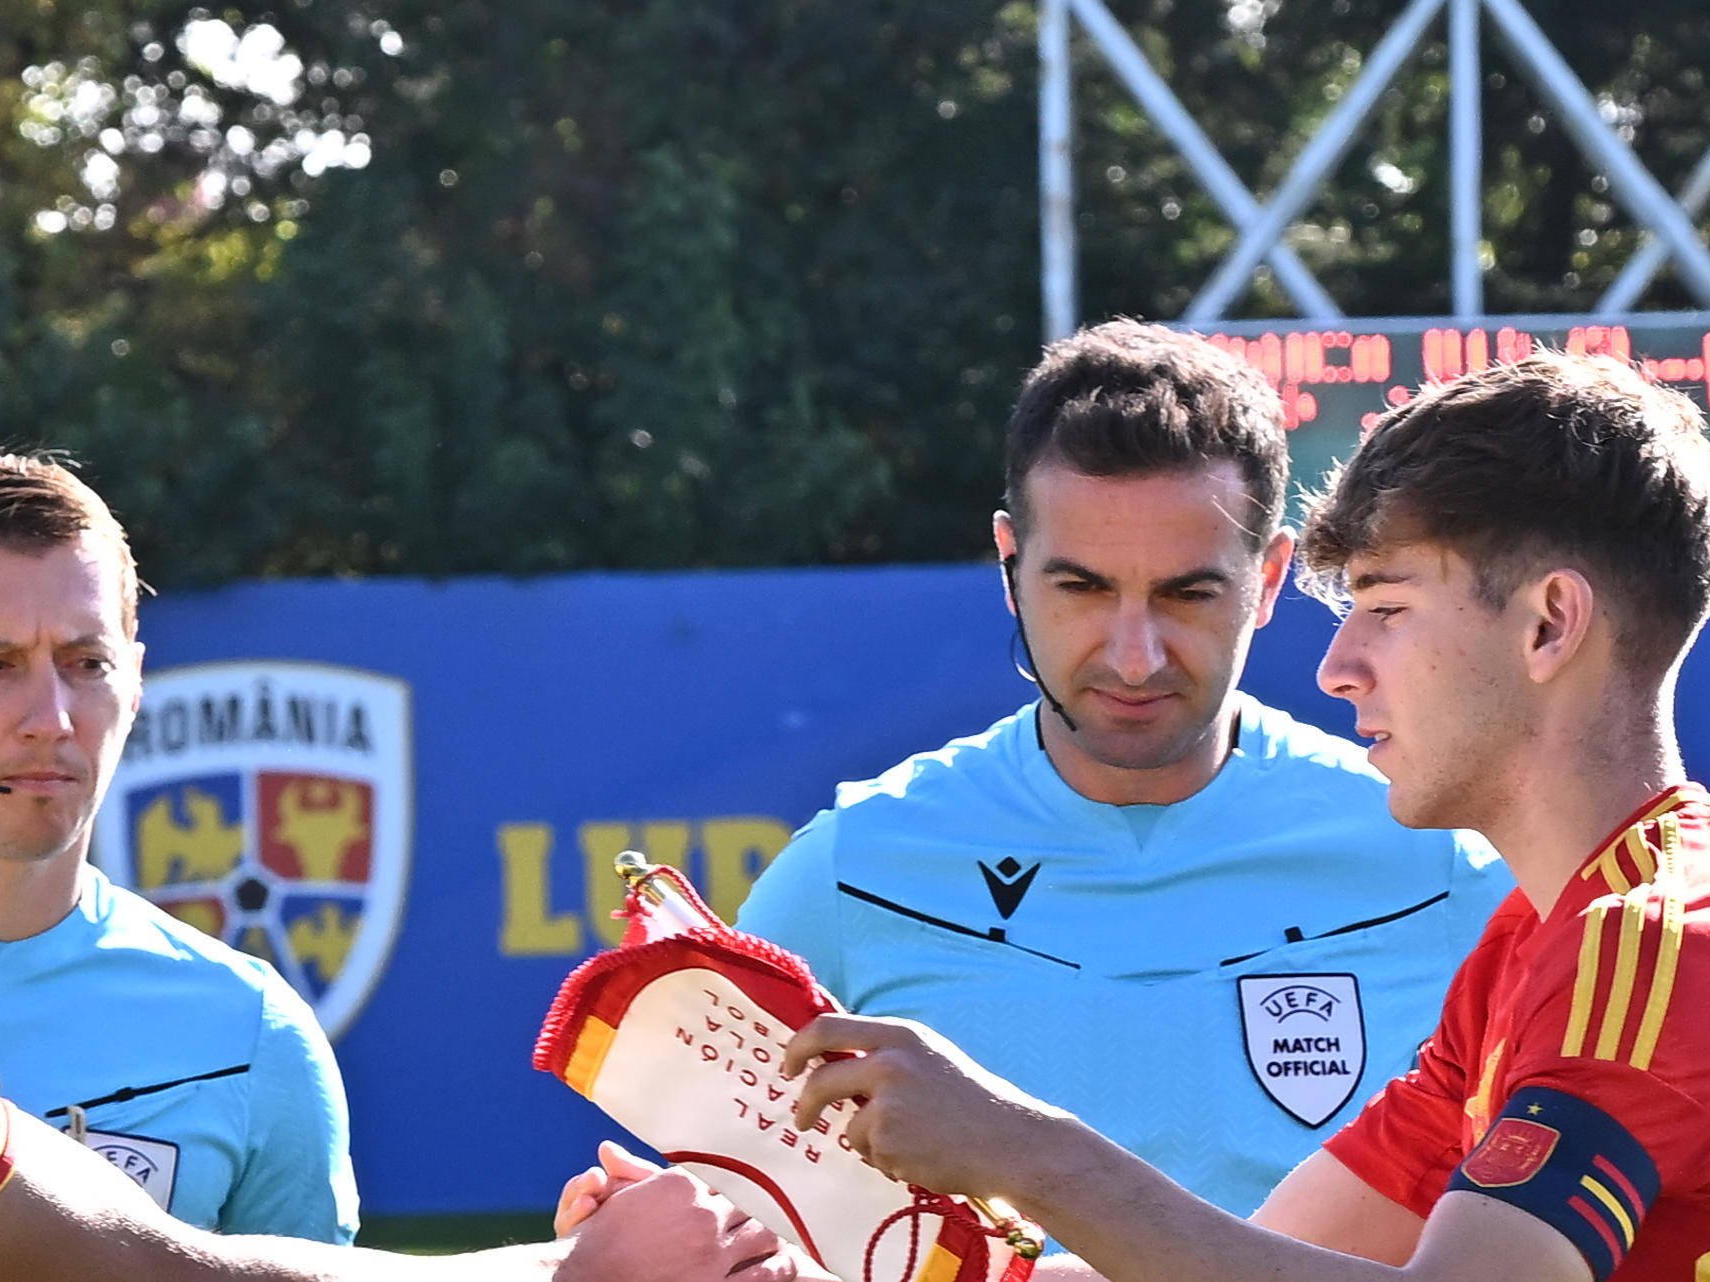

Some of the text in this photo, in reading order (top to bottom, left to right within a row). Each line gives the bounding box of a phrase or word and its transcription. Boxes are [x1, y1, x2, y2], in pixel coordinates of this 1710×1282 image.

[1265, 992, 1333, 1017] UEFA
[1273, 1037, 1340, 1054] MATCH
[1266, 1060, 1351, 1077] OFFICIAL
[676, 1027, 866, 1158] ERACIÓN
[734, 1097, 821, 1163] REAL
[105, 1151, 151, 1184] EFA
